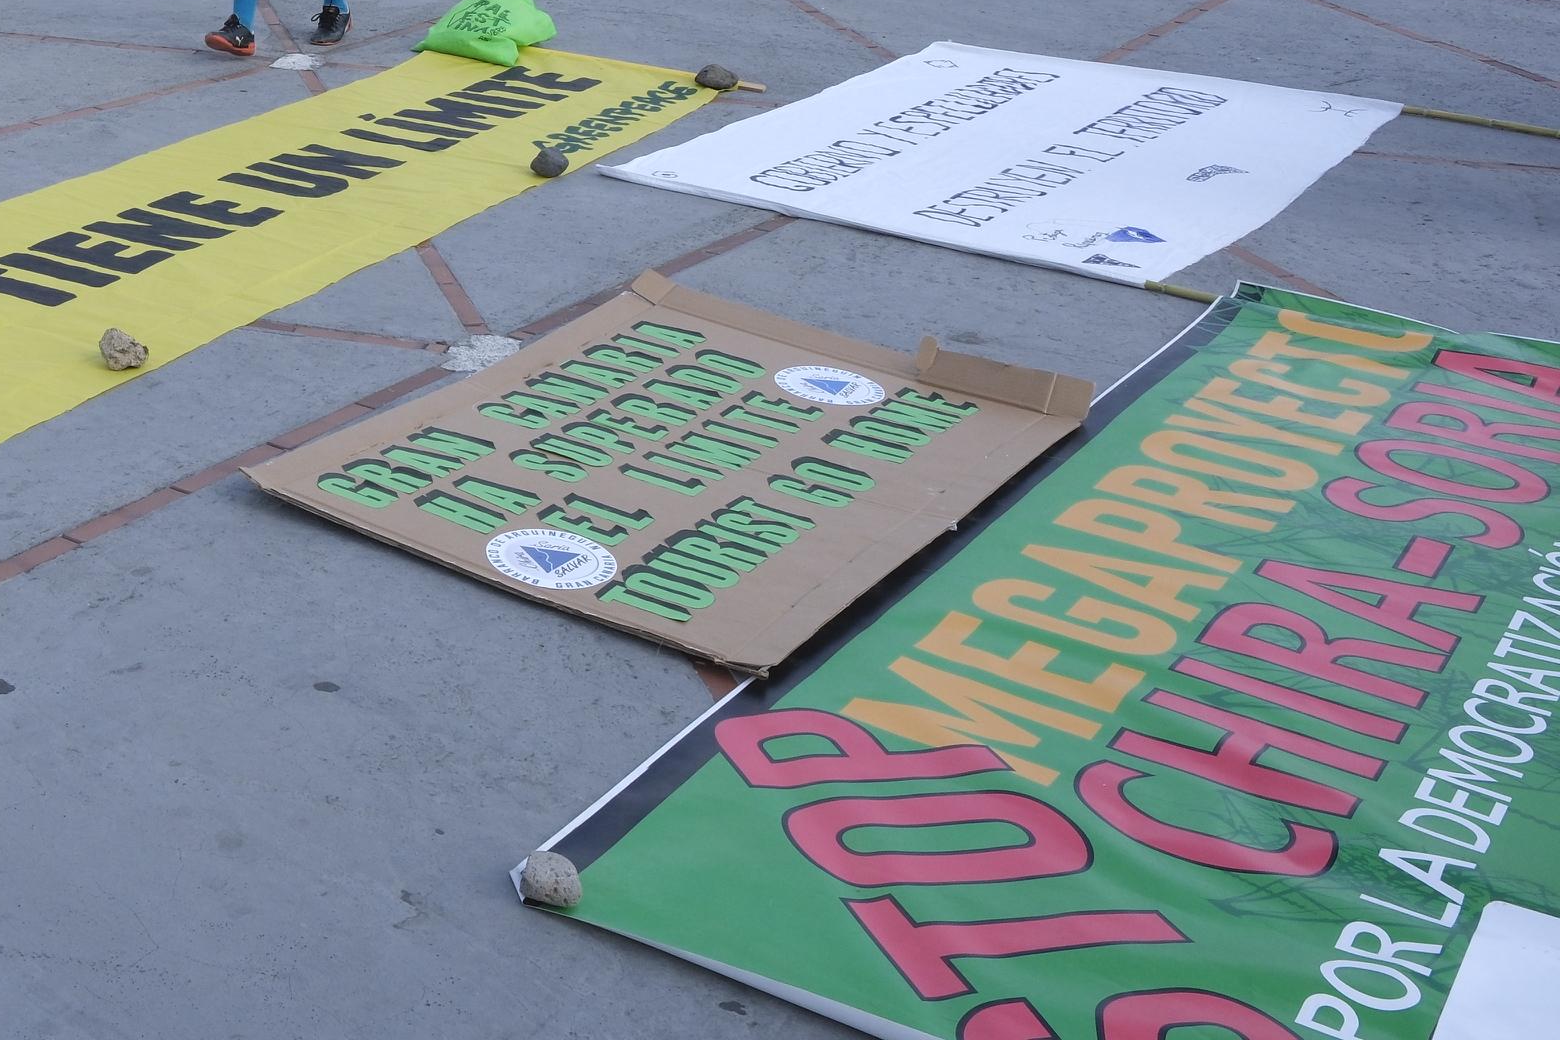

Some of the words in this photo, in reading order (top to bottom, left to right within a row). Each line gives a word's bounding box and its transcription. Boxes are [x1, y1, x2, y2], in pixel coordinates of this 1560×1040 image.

[218, 143, 407, 198] UN
[340, 66, 603, 152] LÍMITE
[1042, 144, 1126, 163] EL
[1073, 86, 1228, 143] TERRITORIO
[749, 139, 901, 192] GOBIERNO
[856, 128, 918, 146] Y
[912, 159, 1085, 228] DESTRUYEN
[317, 426, 496, 508] GRAN
[477, 320, 707, 430] CANARIA
[413, 474, 542, 534] HA
[509, 349, 767, 482] SUPERADO
[821, 386, 982, 464] HOME
[537, 492, 656, 546] EL
[619, 390, 825, 497] LIMITE
[767, 456, 876, 508] GO
[554, 554, 590, 578] SALVAR
[595, 495, 817, 623] TOURIST
[1358, 848, 1477, 928] LA
[1294, 920, 1443, 1040] POR
